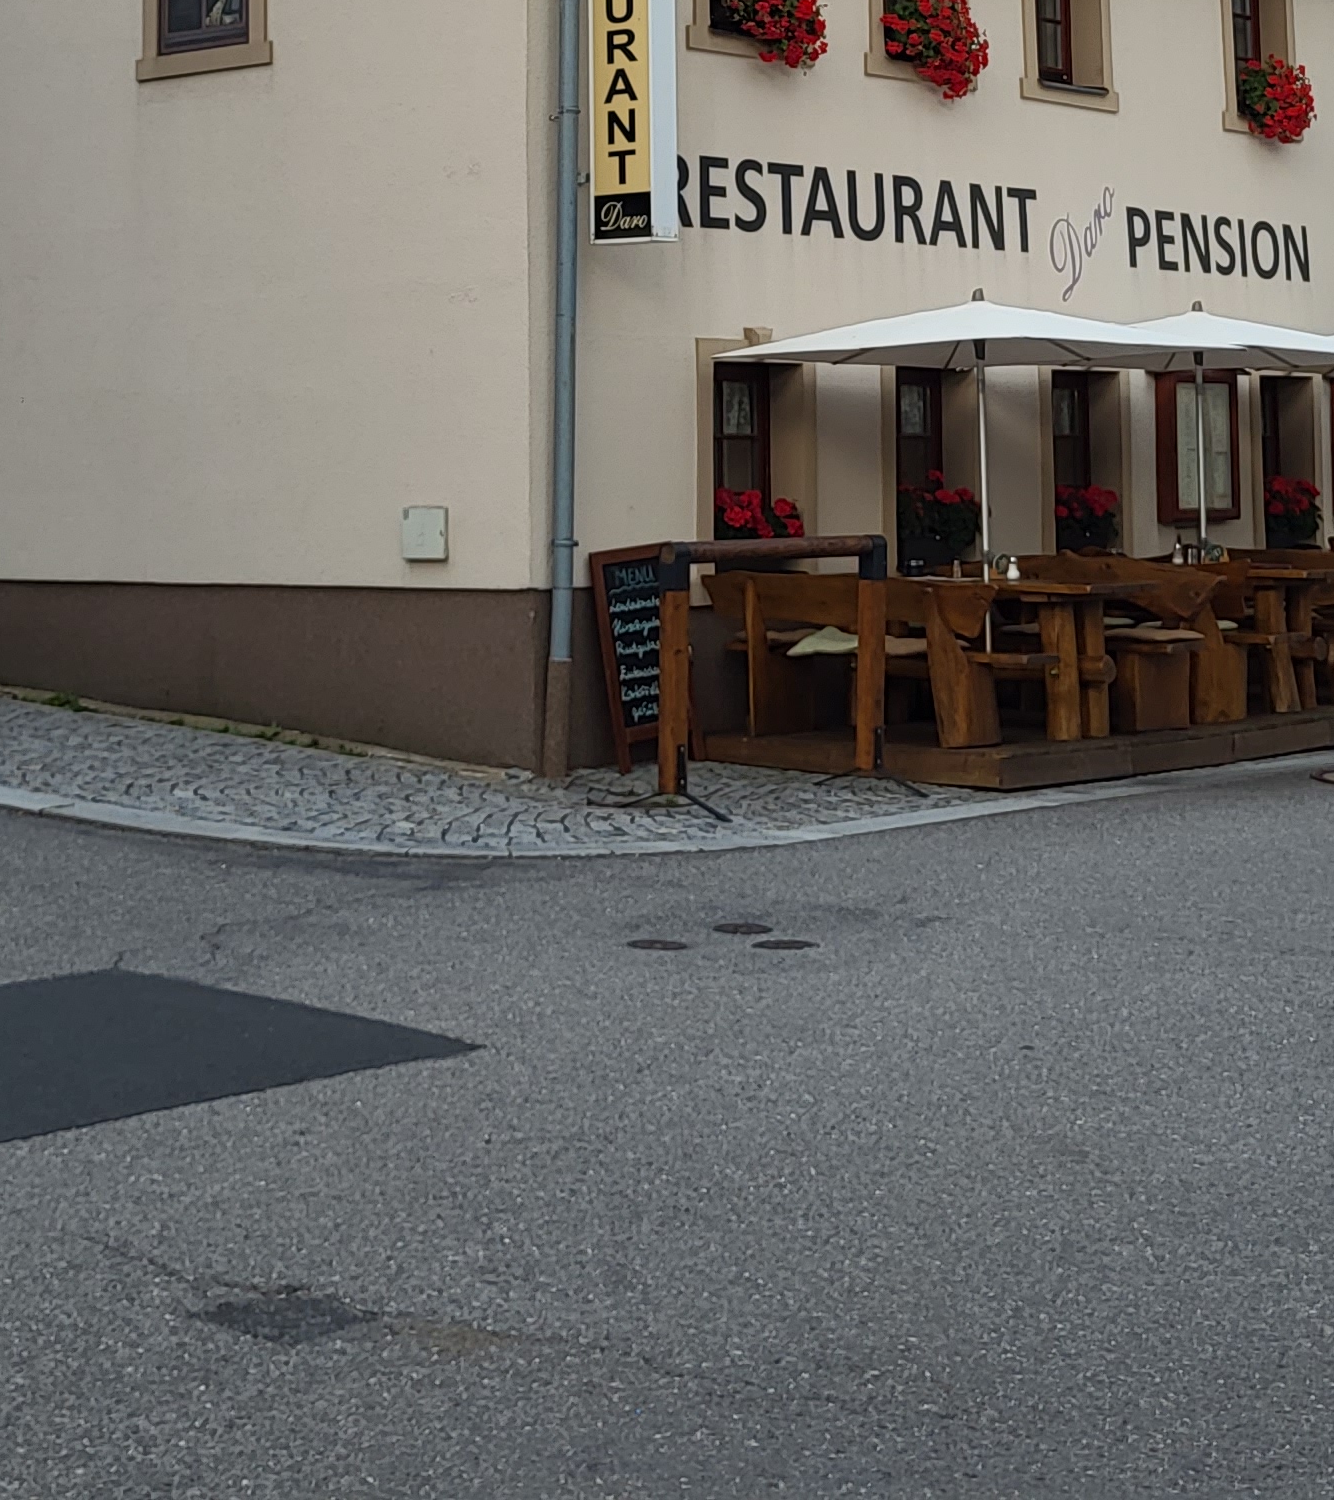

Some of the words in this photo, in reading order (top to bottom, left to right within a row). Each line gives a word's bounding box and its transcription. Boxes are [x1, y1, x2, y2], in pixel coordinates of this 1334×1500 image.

[600, 201, 648, 231] Daro
[1049, 186, 1114, 302] Daro
[1126, 206, 1310, 283] PENSION
[615, 565, 656, 586] MENU
